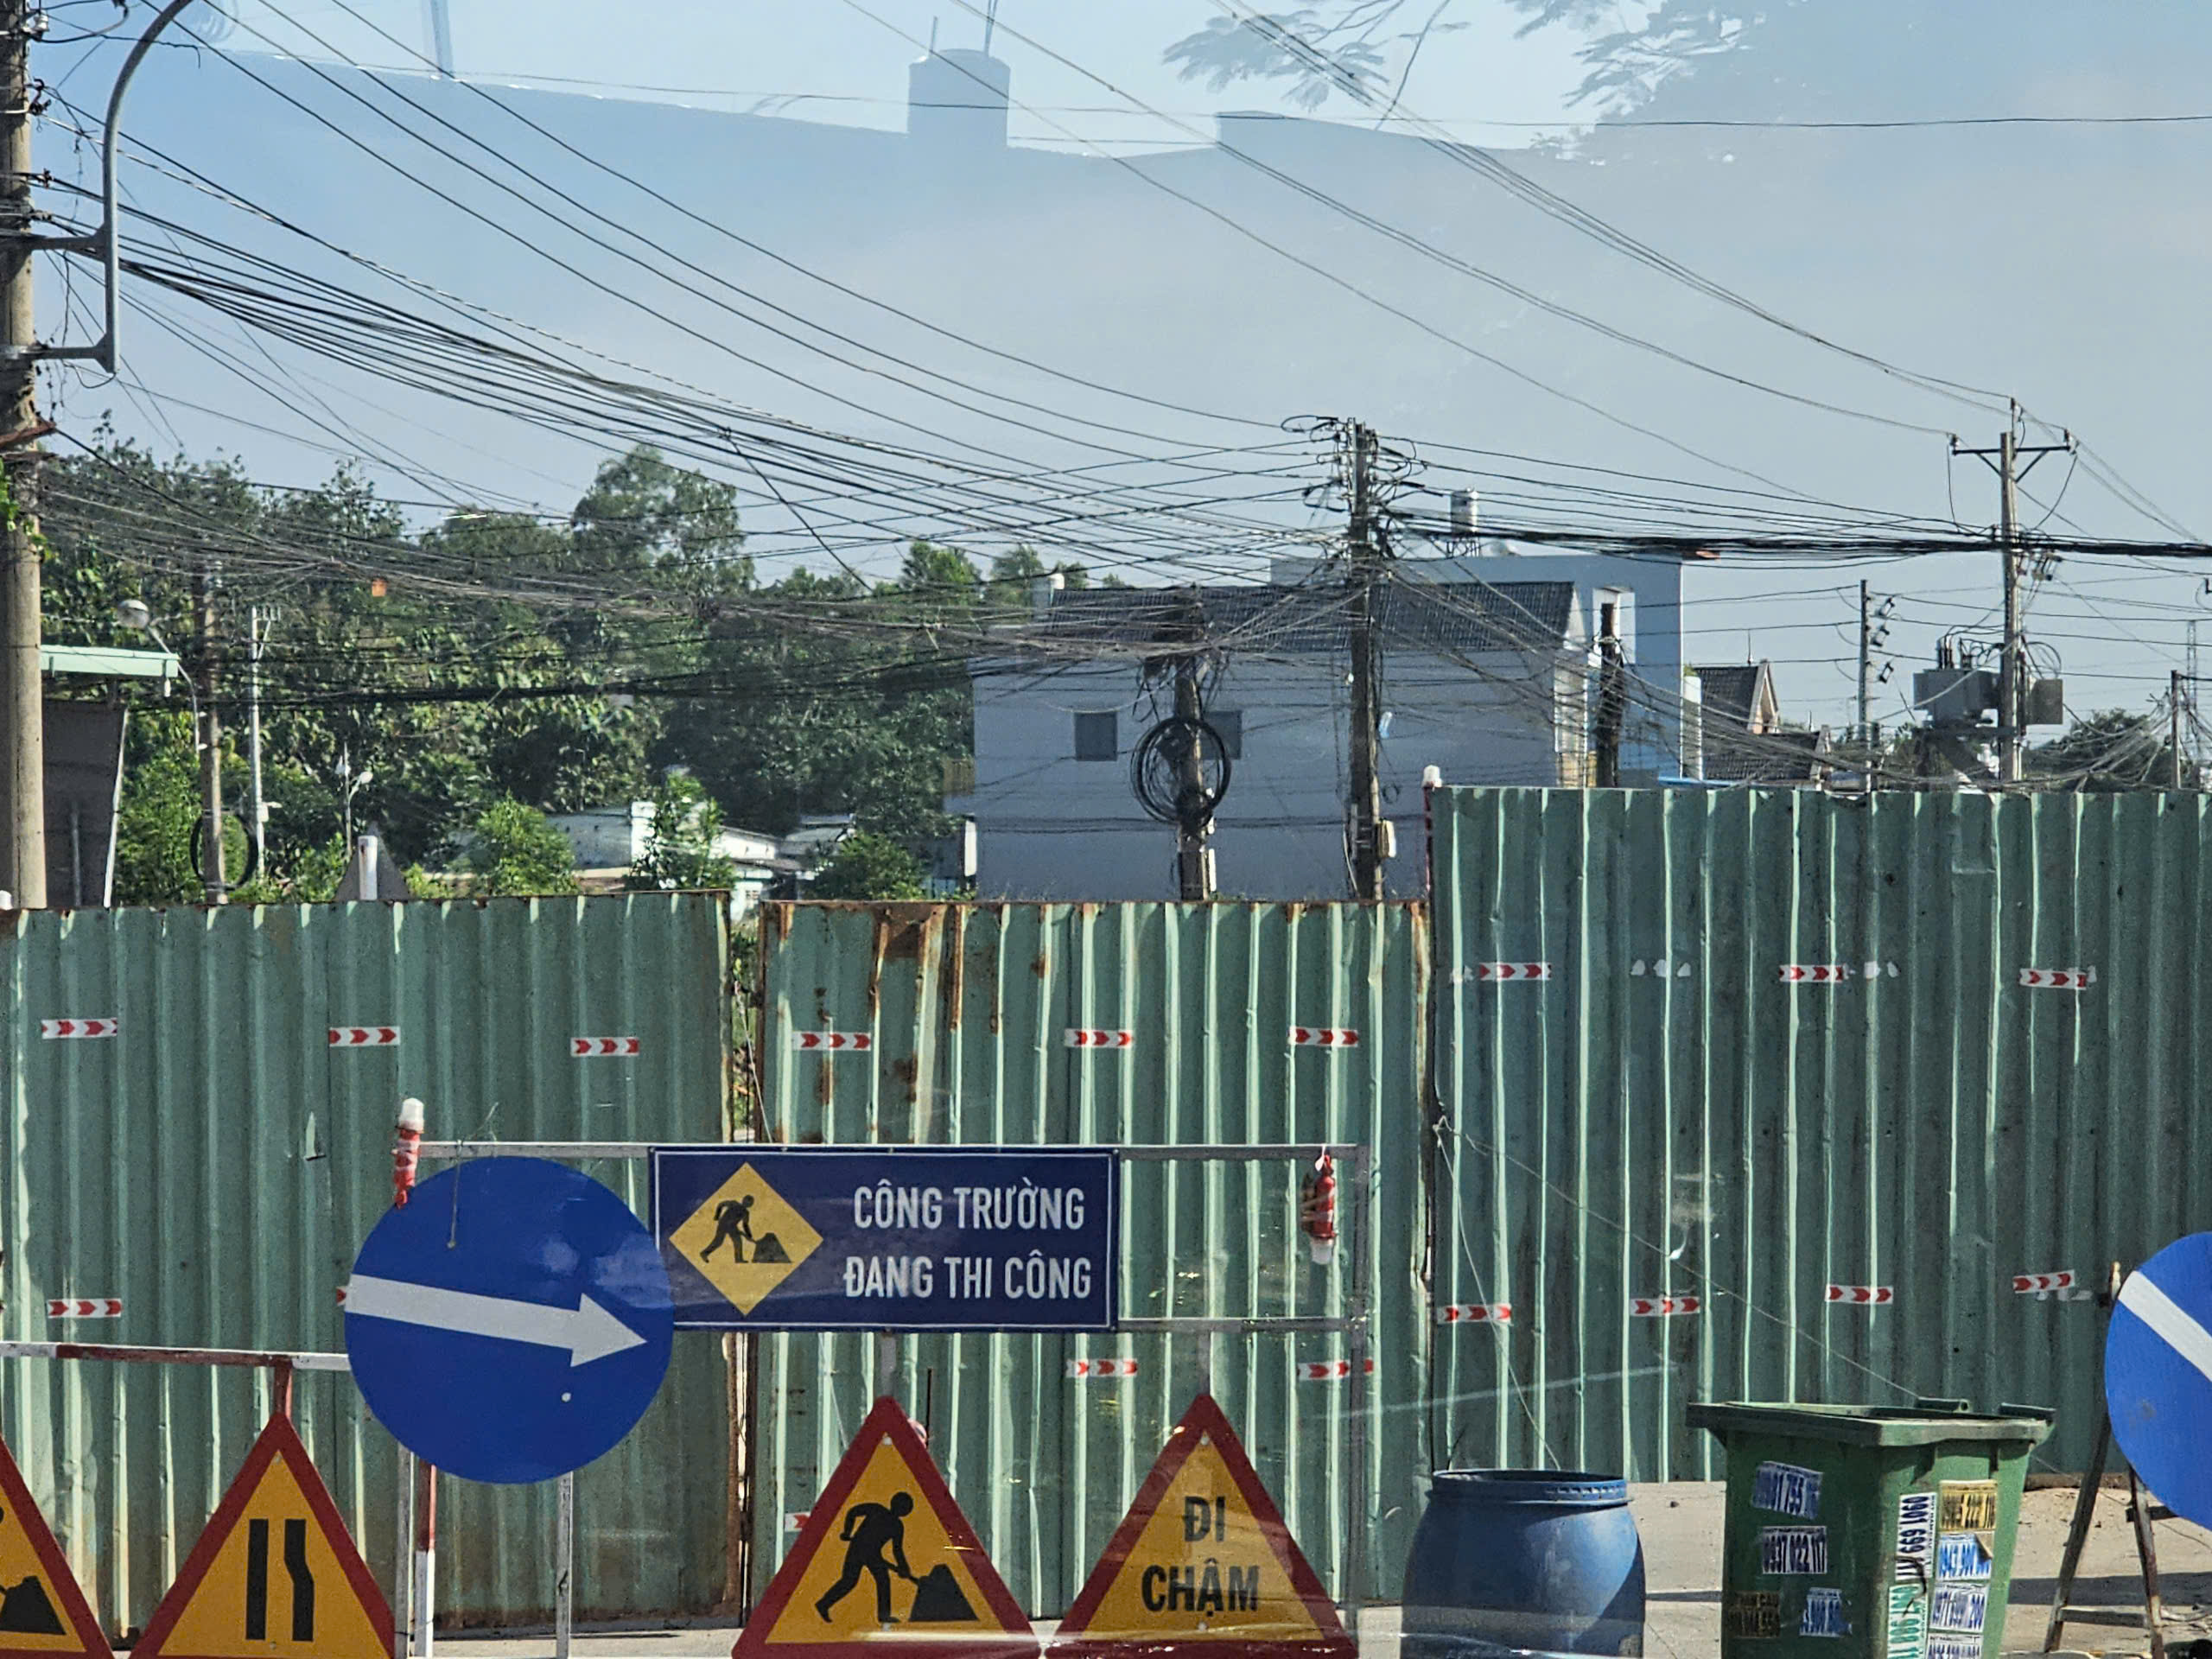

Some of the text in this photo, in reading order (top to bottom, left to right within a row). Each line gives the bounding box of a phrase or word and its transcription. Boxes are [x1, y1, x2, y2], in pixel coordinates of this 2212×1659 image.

[854, 1176, 1085, 1230] CÔNG TRƯỜNG
[843, 1249, 1091, 1299] ĐANG THI CÔNG
[1181, 1495, 1226, 1543] ĐI
[1141, 1557, 1261, 1618] CHẬM
